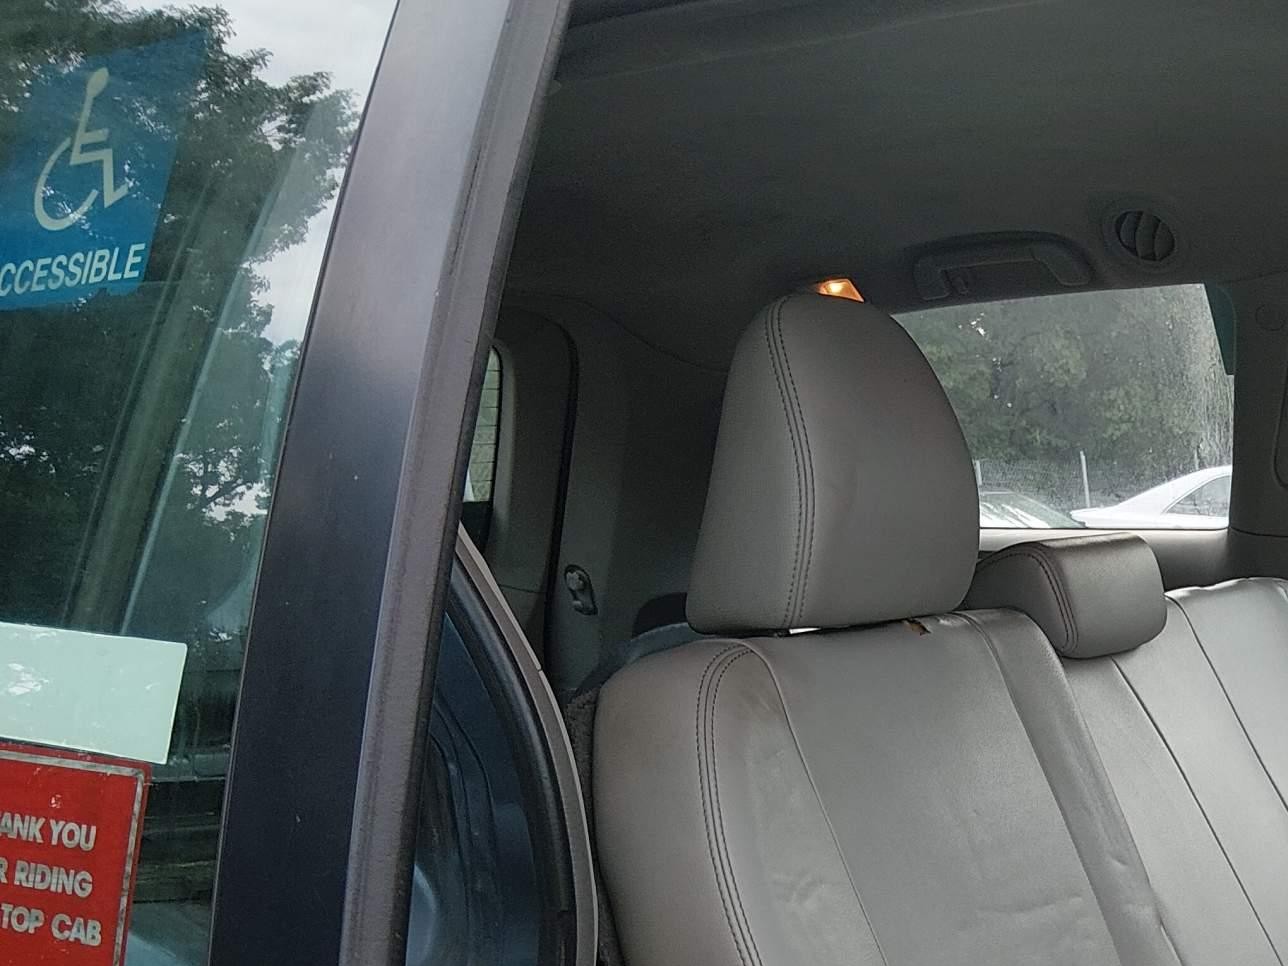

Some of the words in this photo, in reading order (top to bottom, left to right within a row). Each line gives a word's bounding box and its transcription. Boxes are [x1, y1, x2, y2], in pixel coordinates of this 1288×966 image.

[50, 818, 97, 852] YOU
[14, 859, 93, 898] RIDING
[1, 903, 45, 934] TOP
[51, 913, 102, 947] CAB
